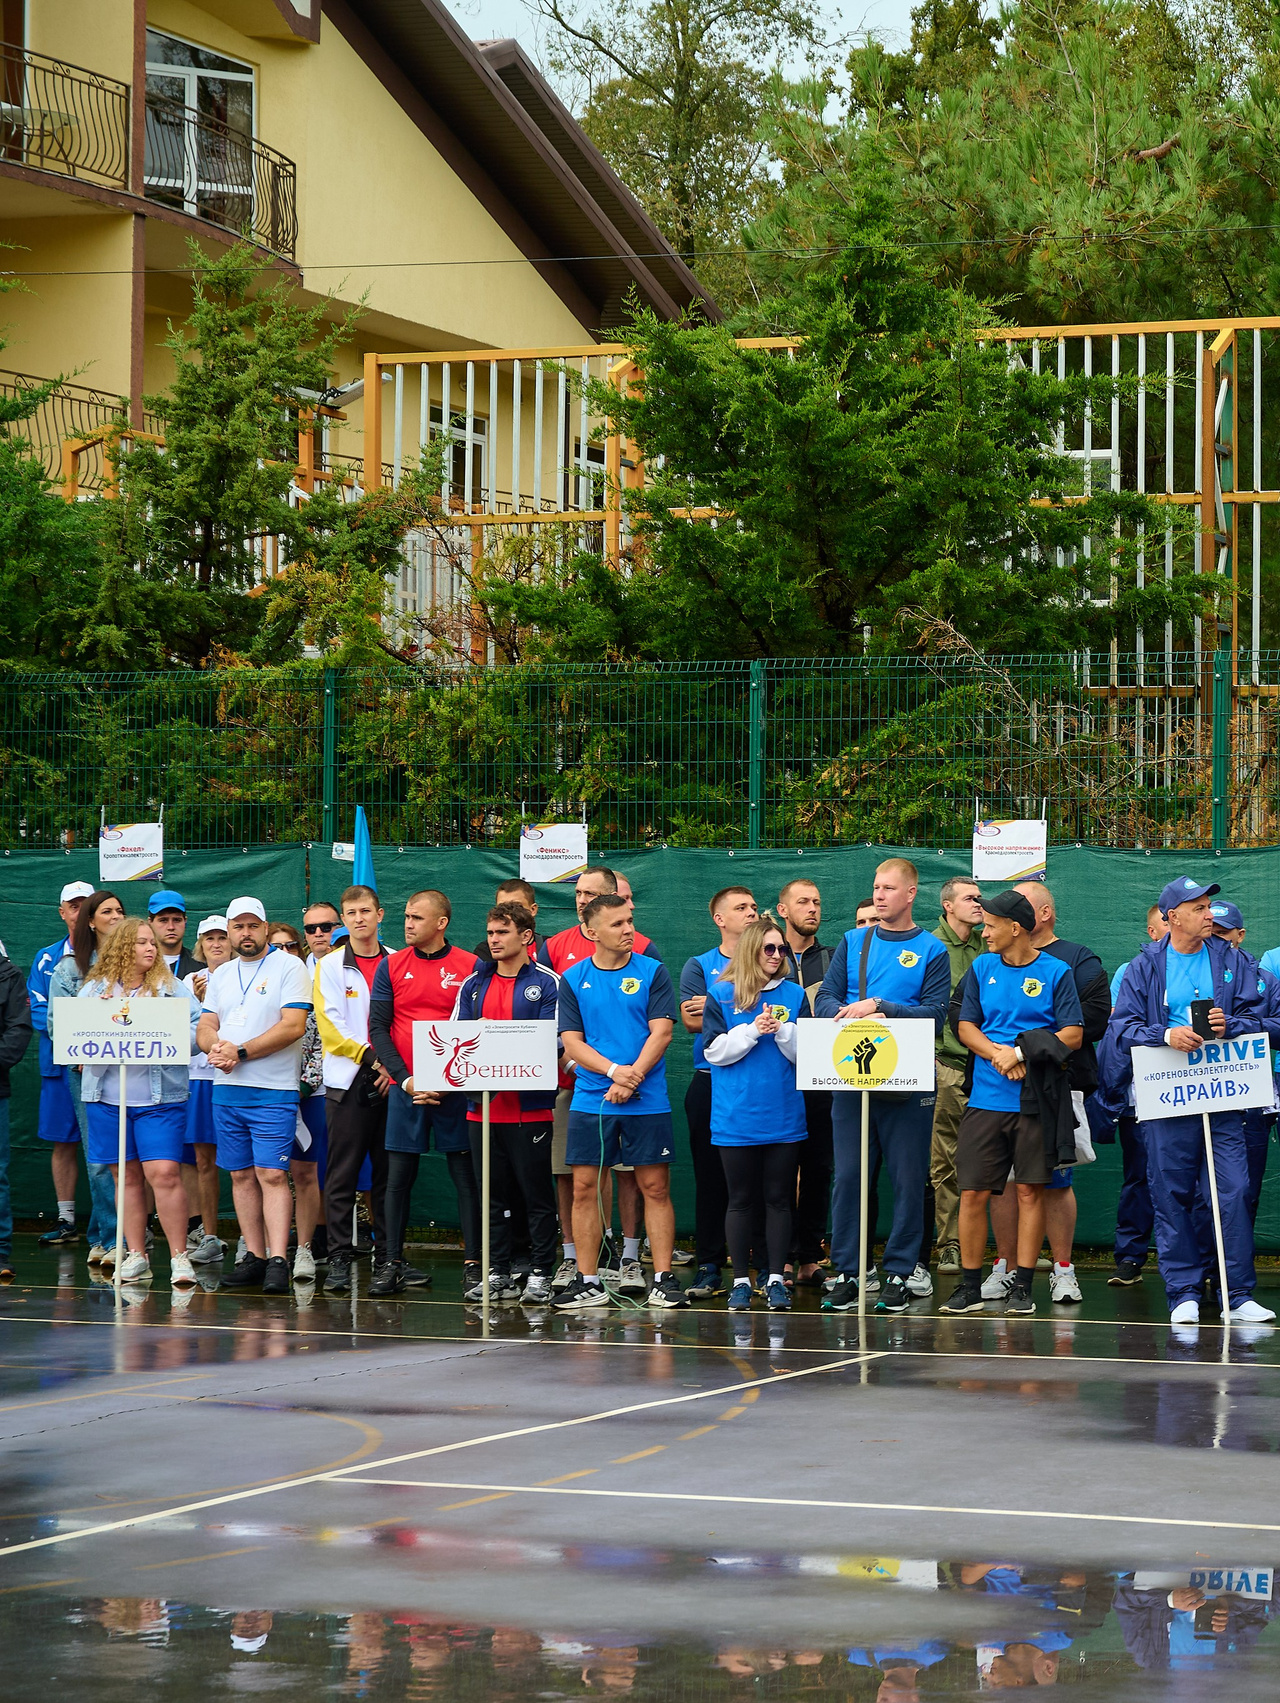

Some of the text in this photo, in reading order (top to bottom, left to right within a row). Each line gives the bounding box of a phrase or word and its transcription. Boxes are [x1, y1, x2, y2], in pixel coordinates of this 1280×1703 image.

[67, 1040, 178, 1058] «ФАКЕЛ»
[1187, 1038, 1266, 1066] DRIVE
[457, 1061, 543, 1078] Феникс
[1143, 1062, 1260, 1082] «КОРЕНОВСКЭЛЕКТРОСЕТЬ»
[857, 1078, 918, 1086] НАПРЯЖЕНИЯ
[1159, 1077, 1250, 1107] «ДРАЙВ»
